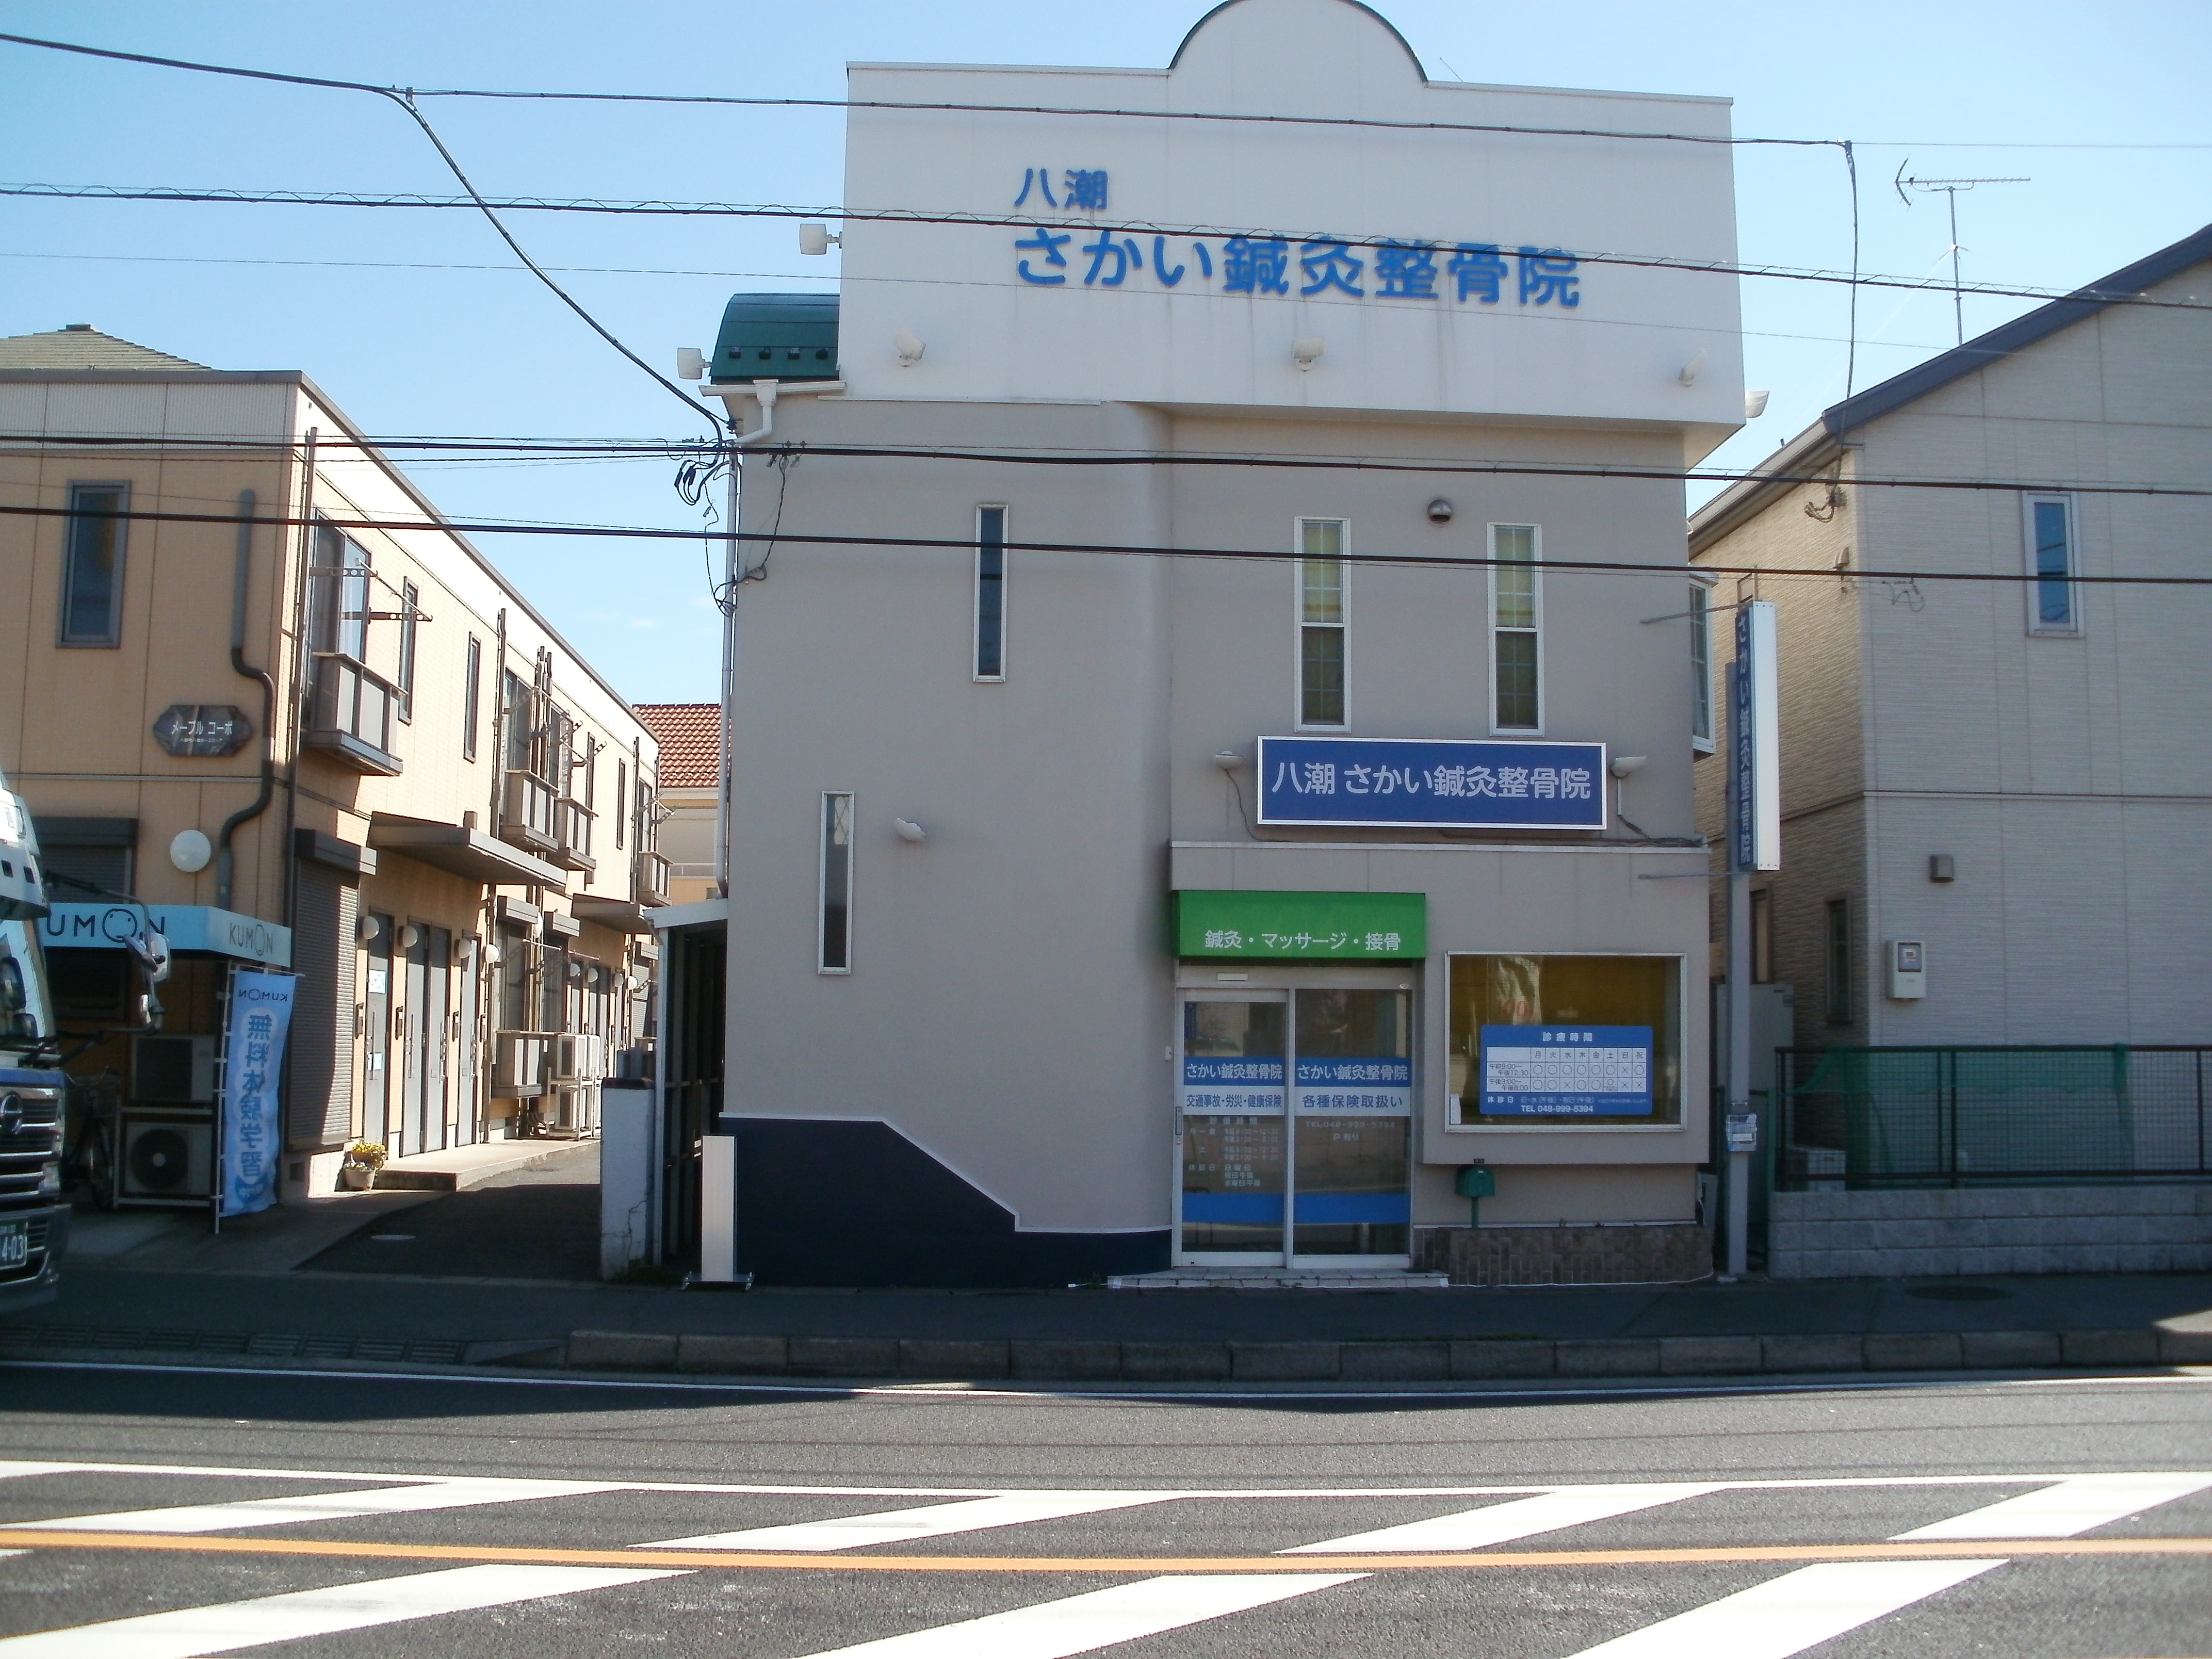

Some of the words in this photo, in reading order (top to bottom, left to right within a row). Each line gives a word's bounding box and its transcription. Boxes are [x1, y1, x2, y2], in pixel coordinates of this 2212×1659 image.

[1014, 168, 1108, 210] 八潮
[1014, 227, 1580, 307] さかい鍼灸整骨院
[1272, 762, 1336, 795] 八潮
[1344, 765, 1590, 799] さかい鍼灸整骨院
[46, 908, 165, 943] UMON
[229, 922, 273, 956] KUMON
[1205, 930, 1401, 951] 鍼灸・マッサージ・接骨
[1186, 1063, 1282, 1079] さかい鍼灸整骨院
[1297, 1065, 1408, 1081] さかい鍼灸整骨院
[1186, 1094, 1282, 1108] 交通事故・労災・健康保険
[1303, 1095, 1403, 1108] 各種保険取扱い
